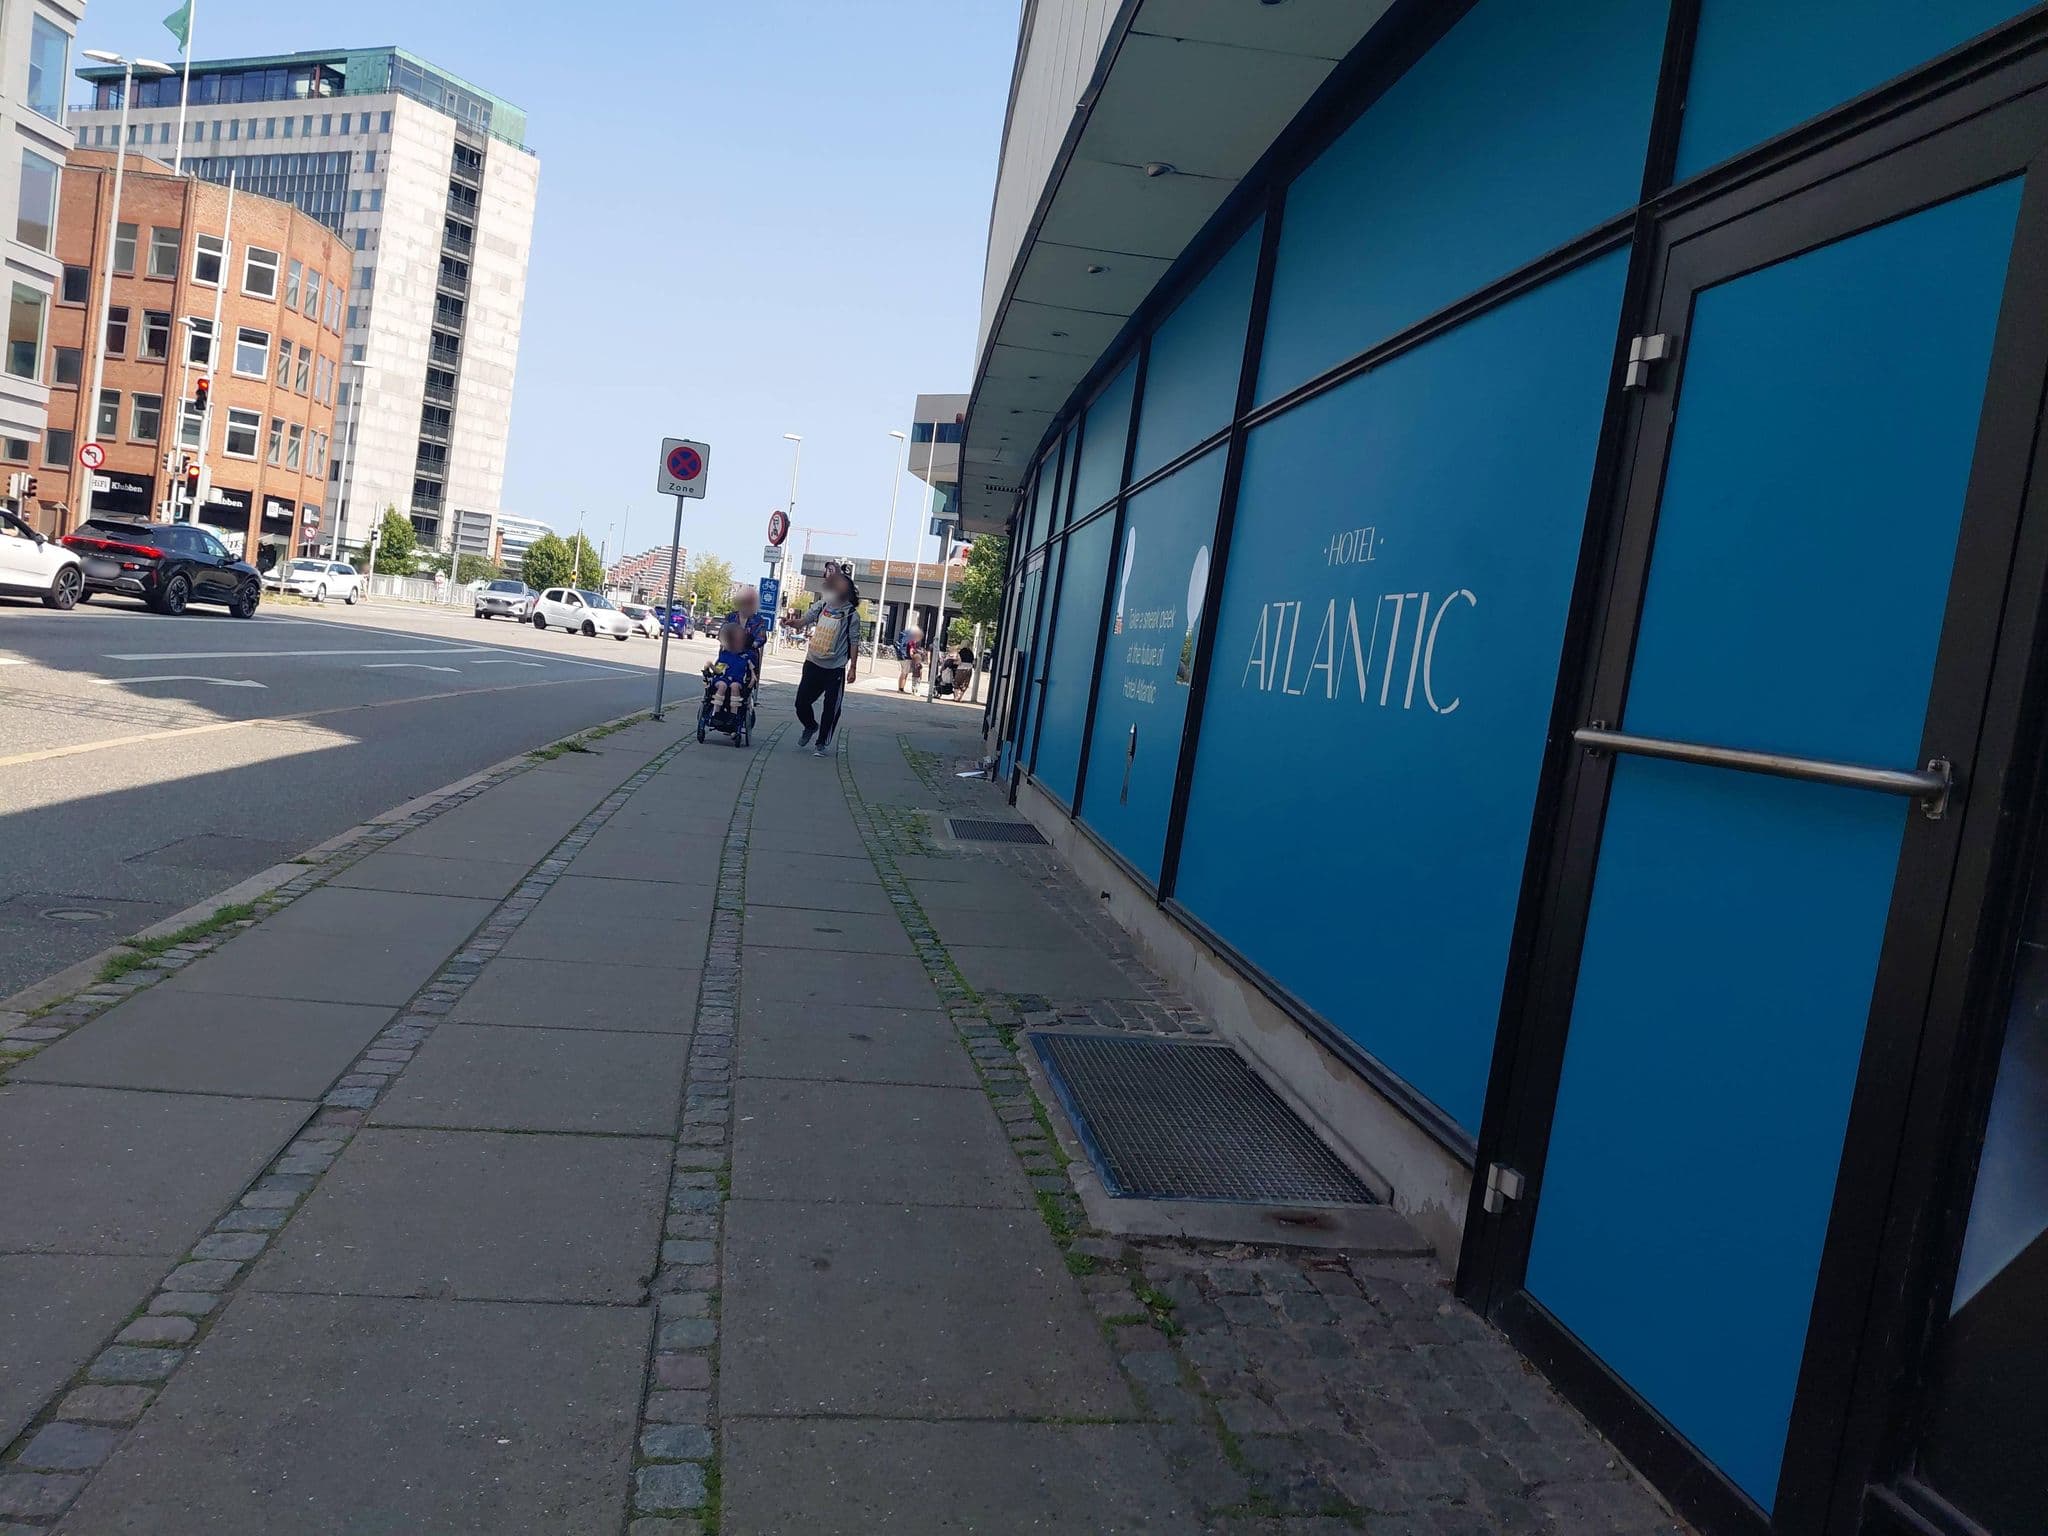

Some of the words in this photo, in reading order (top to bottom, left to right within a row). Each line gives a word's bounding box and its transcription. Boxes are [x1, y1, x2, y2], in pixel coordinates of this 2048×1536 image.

[669, 482, 695, 493] Zone
[1327, 525, 1377, 567] HOTEL
[1241, 588, 1478, 714] ATLANTIC
